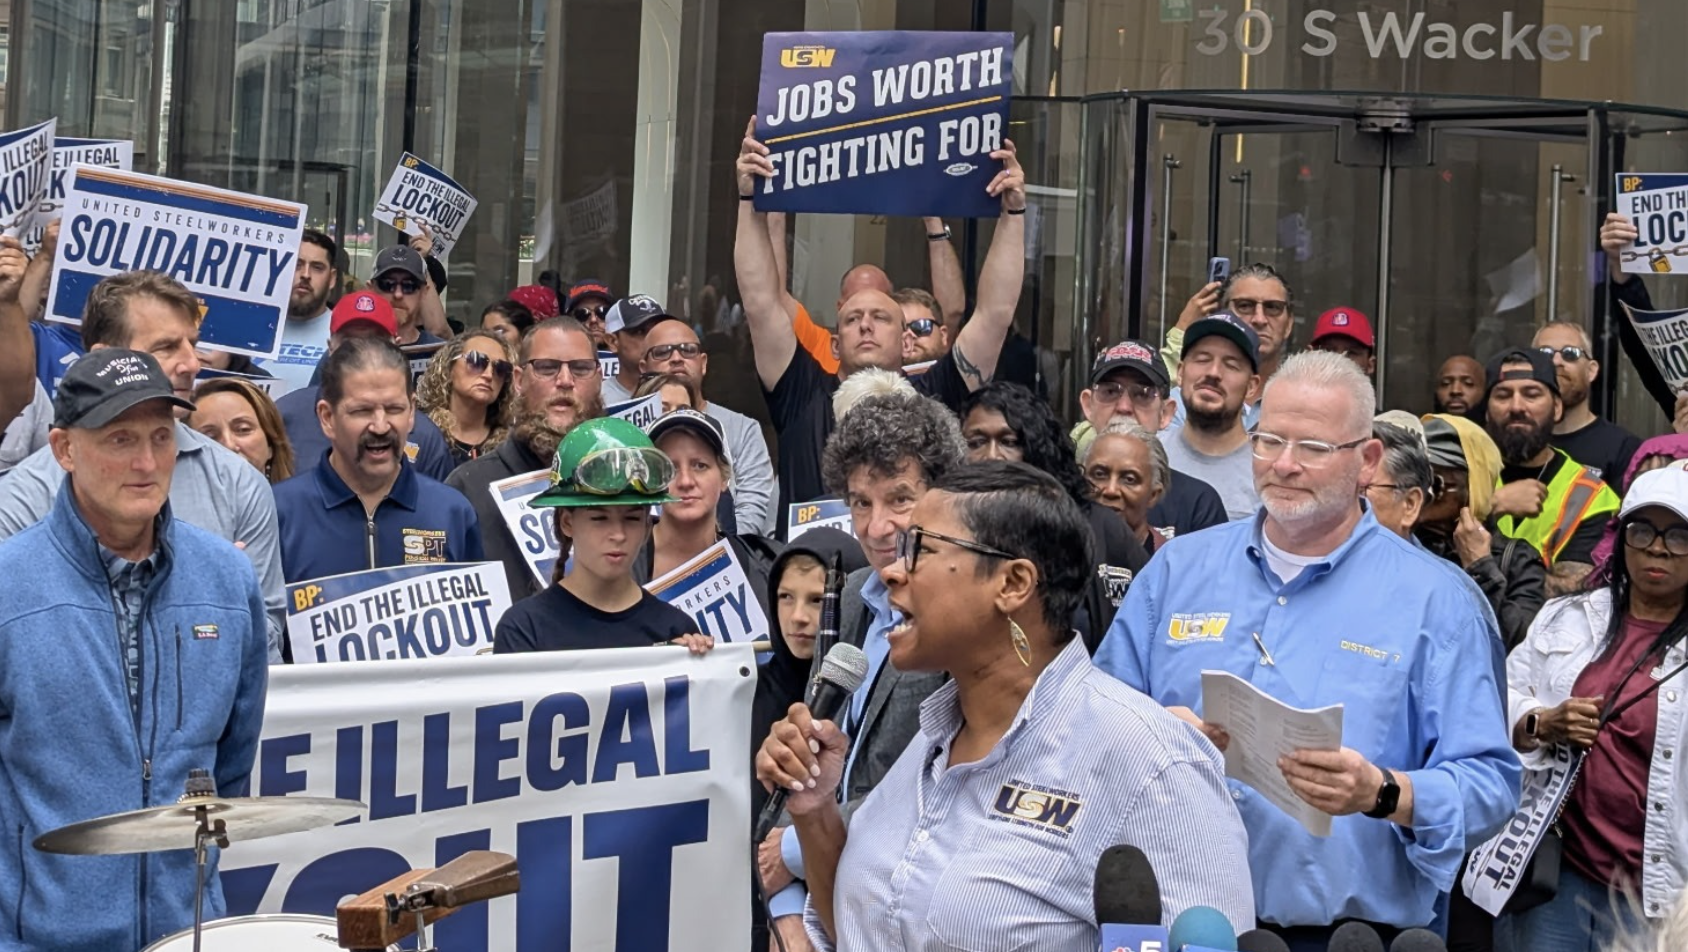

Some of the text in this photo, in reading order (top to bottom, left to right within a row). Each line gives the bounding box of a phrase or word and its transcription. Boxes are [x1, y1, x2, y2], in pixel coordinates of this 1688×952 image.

[1195, 9, 1603, 62] 30 S Wacker
[780, 48, 836, 68] USW
[766, 47, 1003, 126] JOBS WORTH
[3, 131, 49, 173] ILLEGAL
[763, 112, 1001, 194] FIGHTING FOR
[402, 171, 471, 213] END THE ILLEGAL
[1623, 176, 1642, 192] BP:
[1631, 190, 1688, 214] END TH
[82, 198, 285, 244] UNITED STEELWORKERS
[390, 184, 465, 232] LOCKOUT
[1633, 210, 1688, 247] LOC
[63, 214, 294, 296] SOLIDARITY
[96, 356, 148, 377] MUSICIA
[115, 373, 149, 386] UNION
[798, 505, 821, 523] BP:
[403, 535, 447, 557] SPT
[294, 584, 324, 611] BP:
[310, 572, 489, 642] END THE ILLEGAL
[1168, 617, 1230, 640] USW
[1340, 640, 1401, 662] DISTRICT 7
[334, 675, 710, 826] ILLEGAL
[994, 785, 1081, 828] USW
[1541, 770, 1566, 808] THE
[1500, 810, 1545, 890] ILLEGAL
